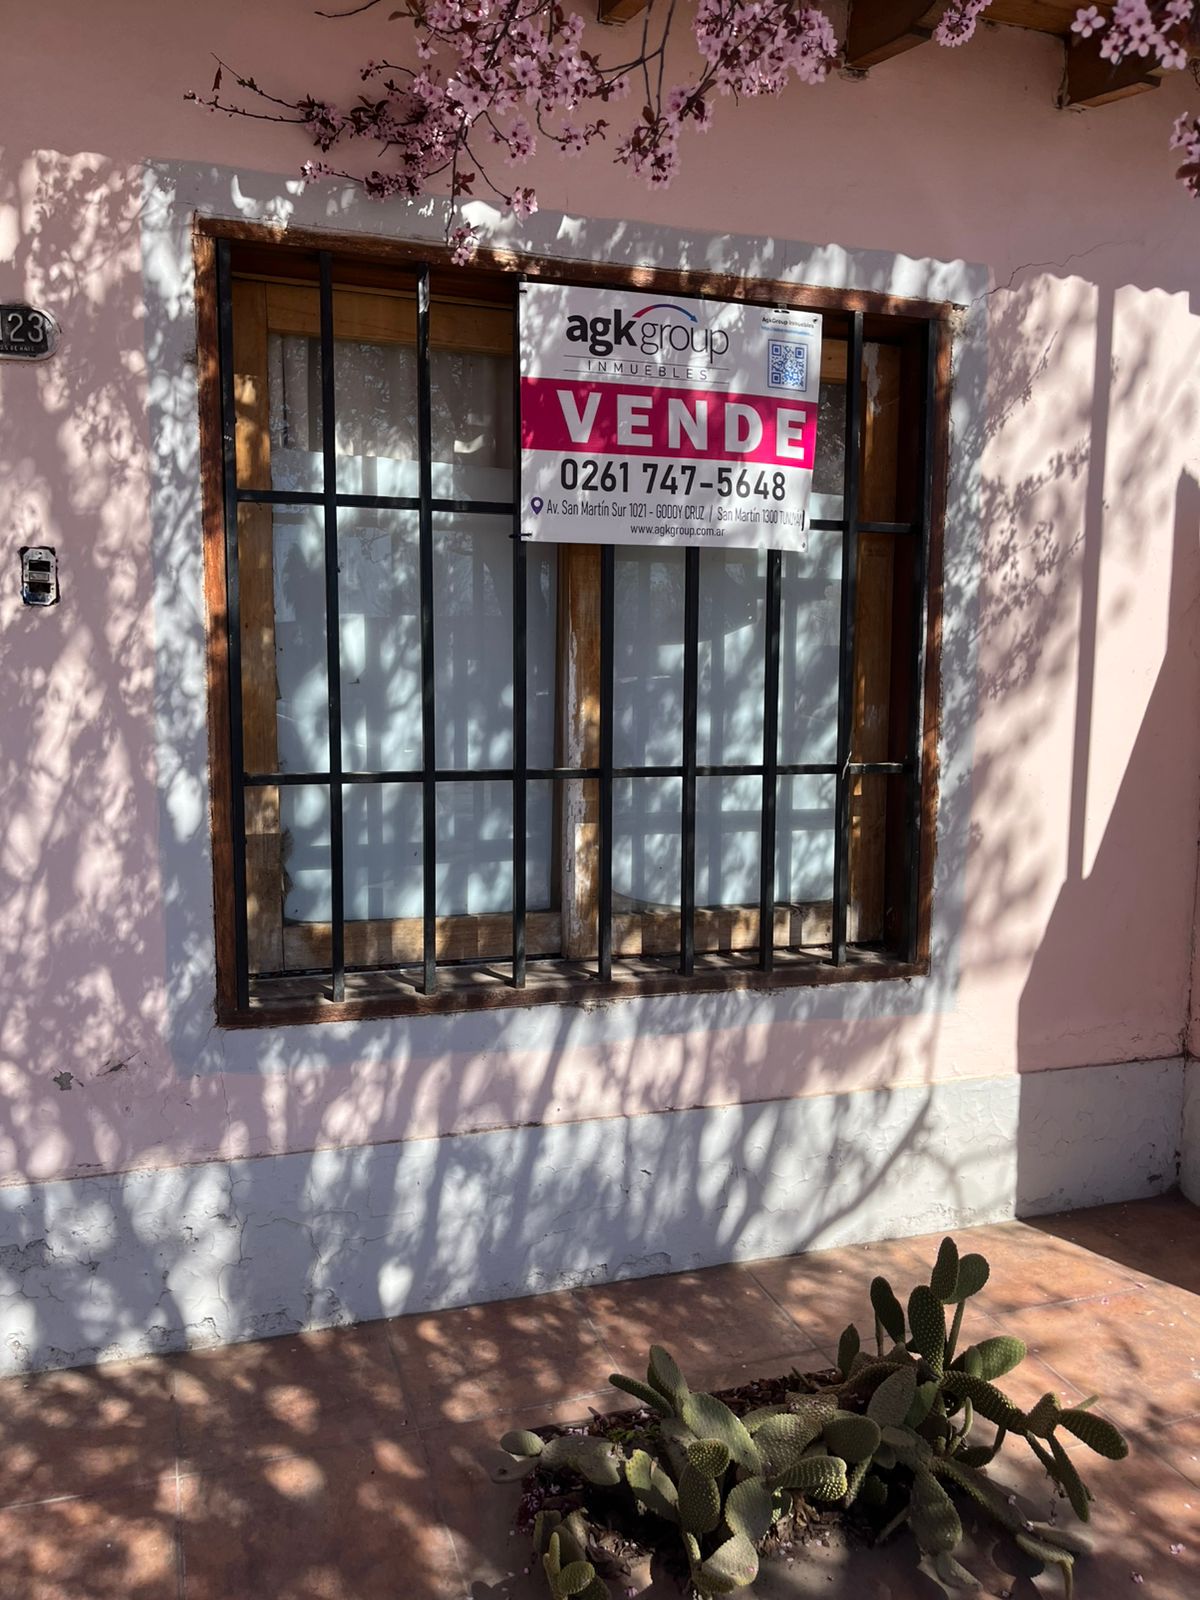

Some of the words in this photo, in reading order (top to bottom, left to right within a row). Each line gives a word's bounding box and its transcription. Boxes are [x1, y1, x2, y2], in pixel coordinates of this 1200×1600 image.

[588, 360, 708, 380] INMUEBLES
[556, 389, 807, 460] VENDE
[561, 458, 629, 493] 0261
[642, 463, 786, 501] 747-5648
[546, 499, 560, 515] Av.
[562, 499, 579, 516] San
[581, 500, 610, 517] Martín
[611, 502, 627, 517] Sur
[629, 503, 647, 518] 1021
[656, 504, 682, 519] GODOY
[684, 505, 705, 521] CRUZ
[717, 506, 733, 522] San
[735, 506, 761, 523] Martín
[762, 509, 779, 525] 1300
[630, 524, 726, 538] www.agkgroup.com.ar
